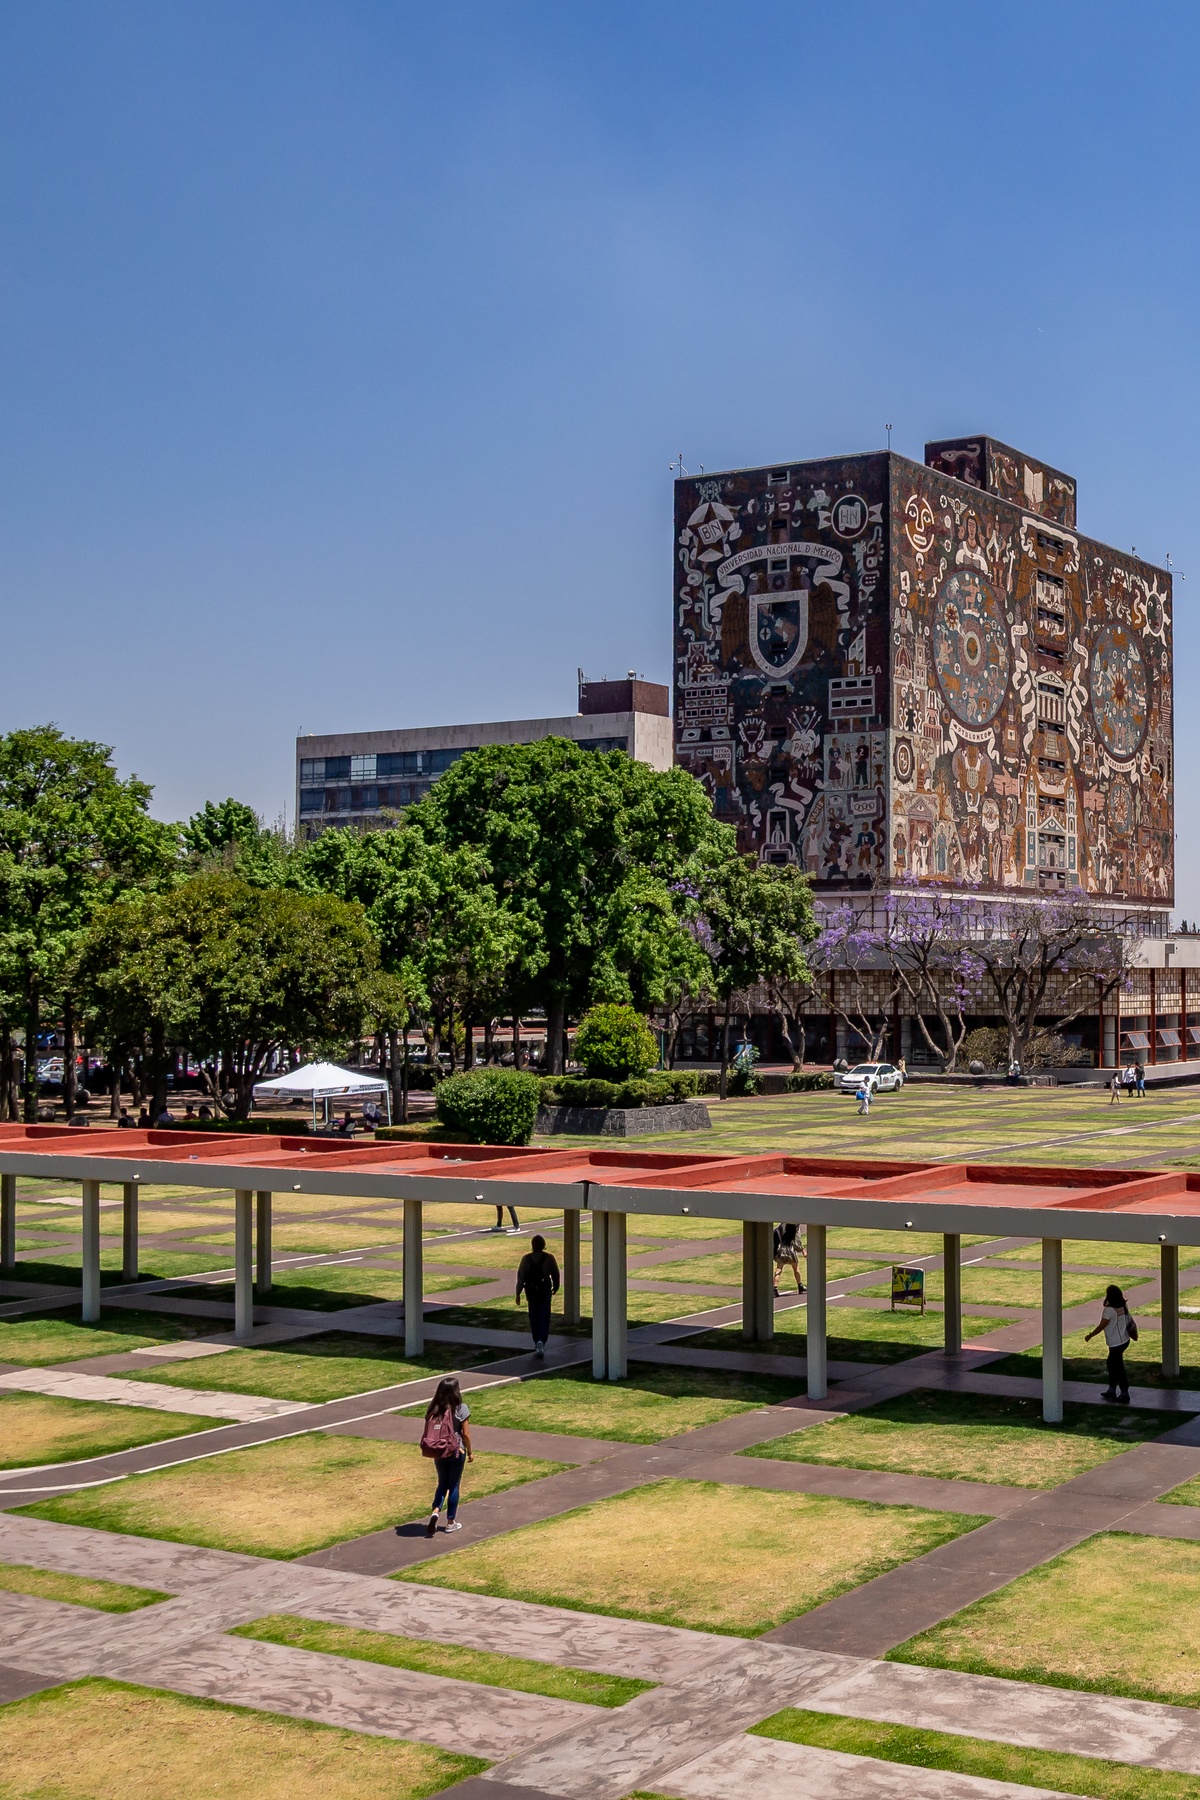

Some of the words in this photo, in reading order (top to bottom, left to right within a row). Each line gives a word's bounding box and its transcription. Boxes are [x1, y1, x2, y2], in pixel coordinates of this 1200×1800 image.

[840, 508, 859, 525] HN
[702, 522, 721, 540] BN
[766, 544, 802, 555] NACIONAL
[794, 742, 811, 752] PAZ
[810, 800, 824, 822] PARIS
